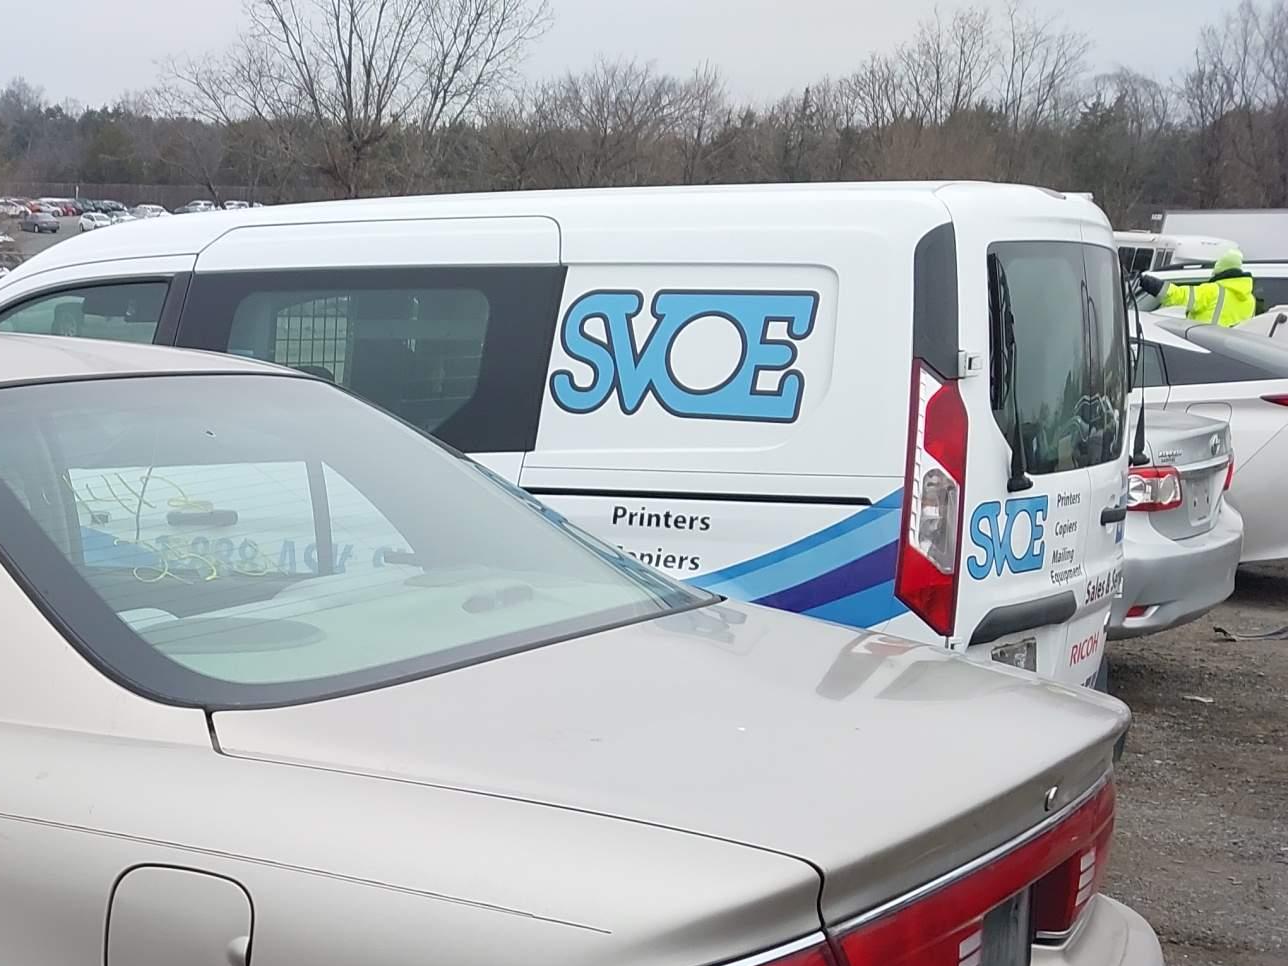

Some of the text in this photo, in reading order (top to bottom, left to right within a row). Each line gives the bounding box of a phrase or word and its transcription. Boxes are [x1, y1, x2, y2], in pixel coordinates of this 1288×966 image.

[550, 288, 820, 424] SVOE
[1057, 492, 1081, 508] Printers
[612, 506, 711, 531] Printers
[1054, 521, 1078, 538] Copiers
[967, 494, 1048, 580] SVOE
[617, 545, 701, 571] piers
[1051, 547, 1075, 563] Mailing
[1050, 564, 1083, 586] Equipment
[1085, 575, 1105, 604] Sales
[1070, 632, 1100, 666] RICOH
